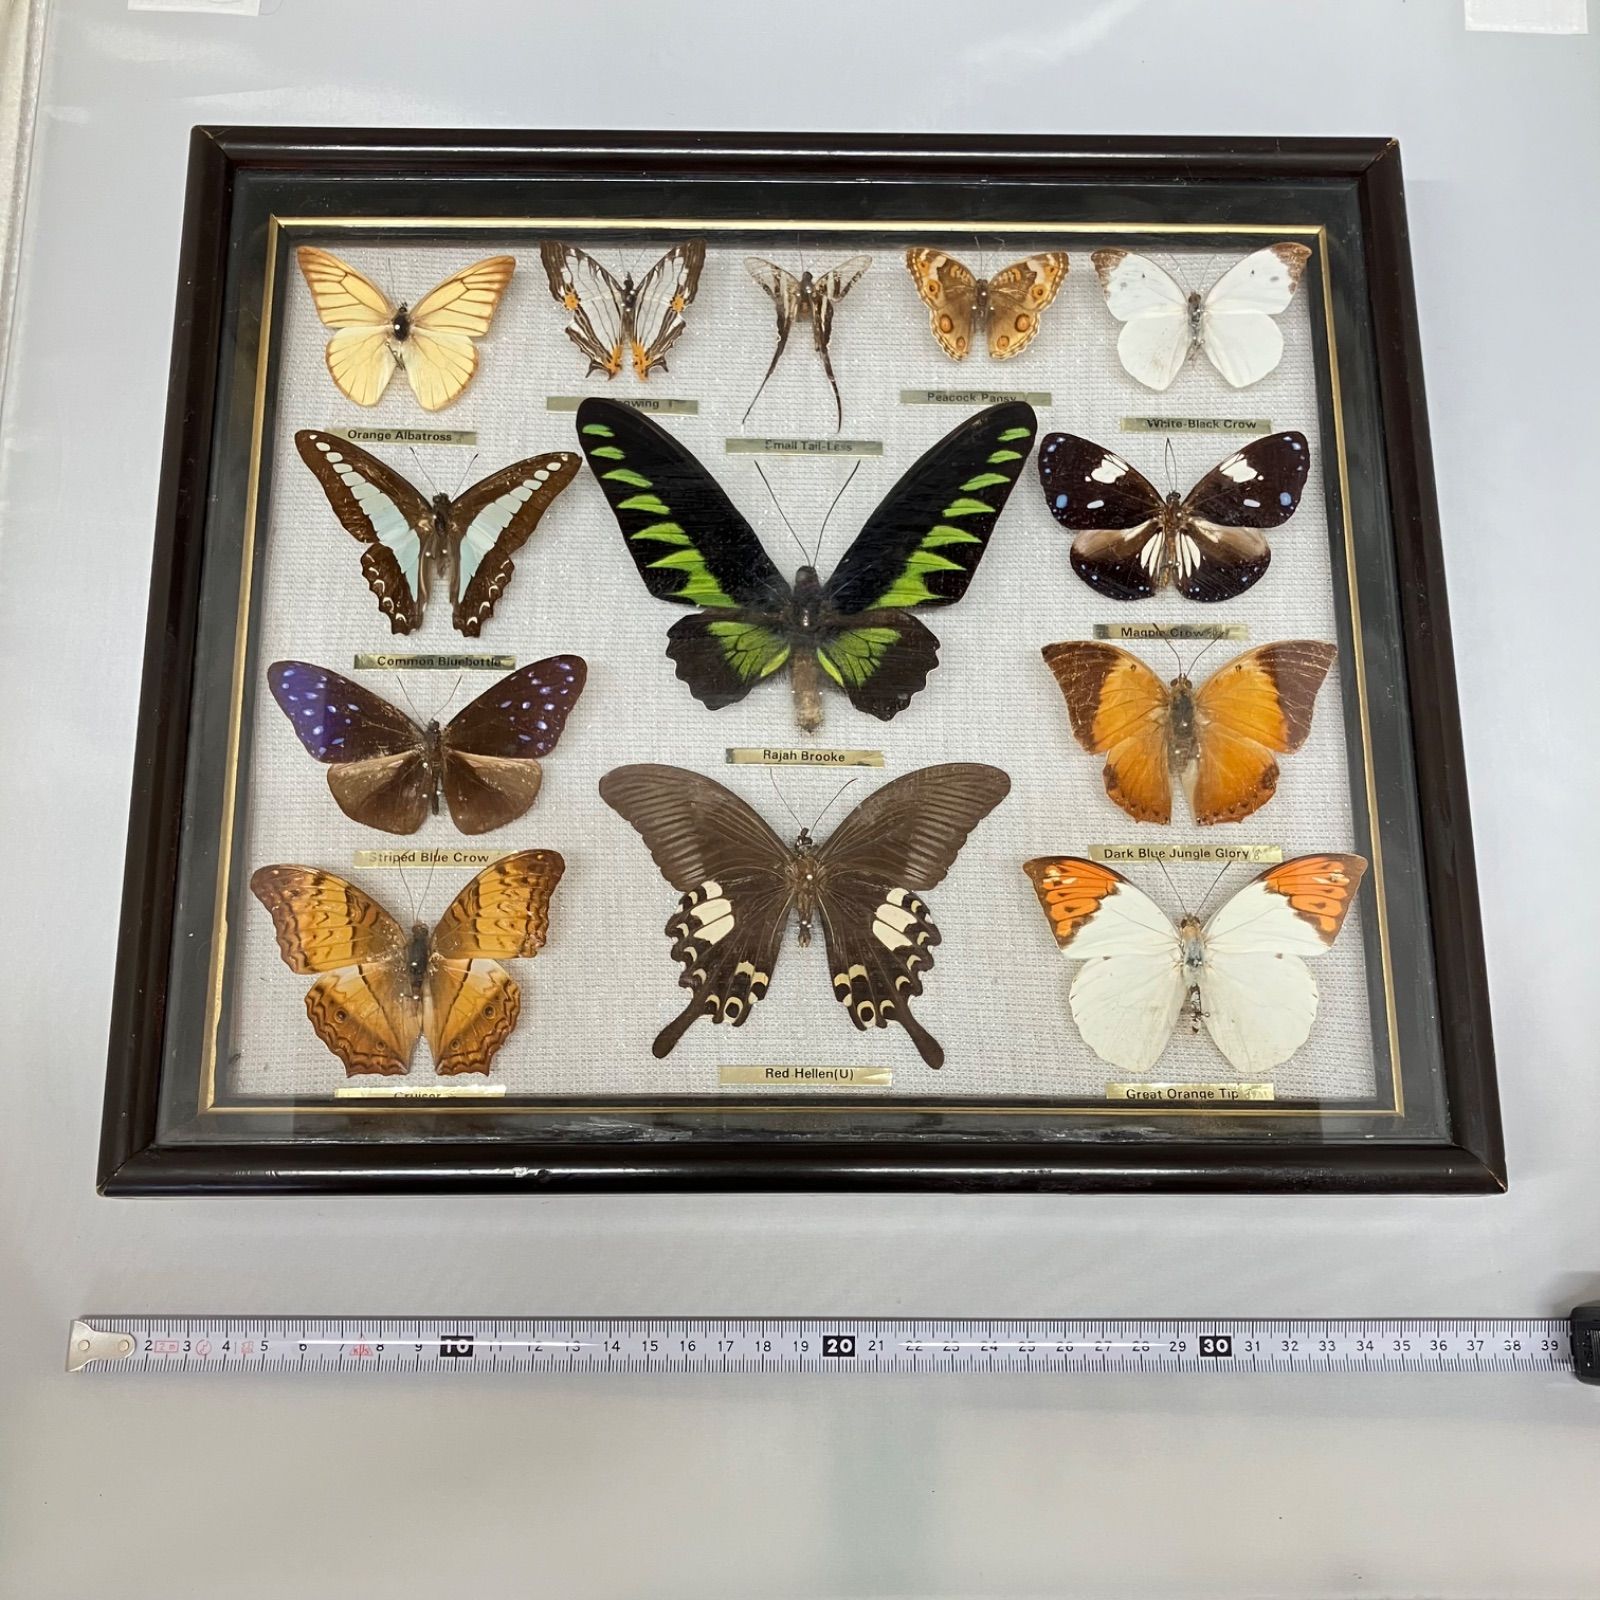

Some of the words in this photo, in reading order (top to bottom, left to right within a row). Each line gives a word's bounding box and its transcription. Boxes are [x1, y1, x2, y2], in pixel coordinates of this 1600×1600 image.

[927, 391, 976, 402] Peacock
[1146, 419, 1218, 429] White-Black
[1223, 420, 1257, 429] Crow
[347, 429, 391, 441] Orange
[395, 431, 452, 442] Albatross
[1170, 627, 1203, 637] Crow
[377, 656, 433, 666] Common
[438, 656, 500, 667] Bluebottle
[763, 749, 797, 762] Rajah
[801, 750, 846, 762] Brooke
[369, 852, 416, 863] Striped
[420, 852, 449, 862] Blue
[453, 852, 489, 862] Crow
[1104, 848, 1134, 859] Dark
[1138, 848, 1166, 859] Blue
[1169, 848, 1211, 860] Jungle
[1215, 848, 1249, 859] Glory
[765, 1067, 790, 1078] Red
[795, 1067, 854, 1081] Hellen(U)
[1126, 1088, 1162, 1100] Great
[1167, 1088, 1215, 1100] Orange
[1219, 1088, 1240, 1100] Tip
[144, 1340, 154, 1352] 2
[183, 1340, 192, 1352] 3
[222, 1340, 230, 1352] 4
[260, 1340, 269, 1352] 5
[446, 1338, 470, 1353] 10
[604, 1340, 620, 1352] 14
[642, 1340, 658, 1352] 15
[680, 1340, 696, 1352] 16
[718, 1340, 734, 1352] 17
[756, 1340, 772, 1352] 18
[794, 1340, 809, 1352] 19
[827, 1338, 853, 1353] 20
[868, 1340, 884, 1352] 21
[1169, 1340, 1186, 1352] 29
[1203, 1338, 1229, 1353] 30
[1244, 1340, 1260, 1352] 31
[1282, 1340, 1298, 1352] 32
[1319, 1340, 1336, 1352] 33
[1356, 1340, 1374, 1352] 34
[1393, 1340, 1411, 1352] 35
[1430, 1340, 1448, 1352] 36
[1466, 1340, 1484, 1352] 37
[1504, 1340, 1522, 1352] 38
[1541, 1340, 1559, 1352] 39
